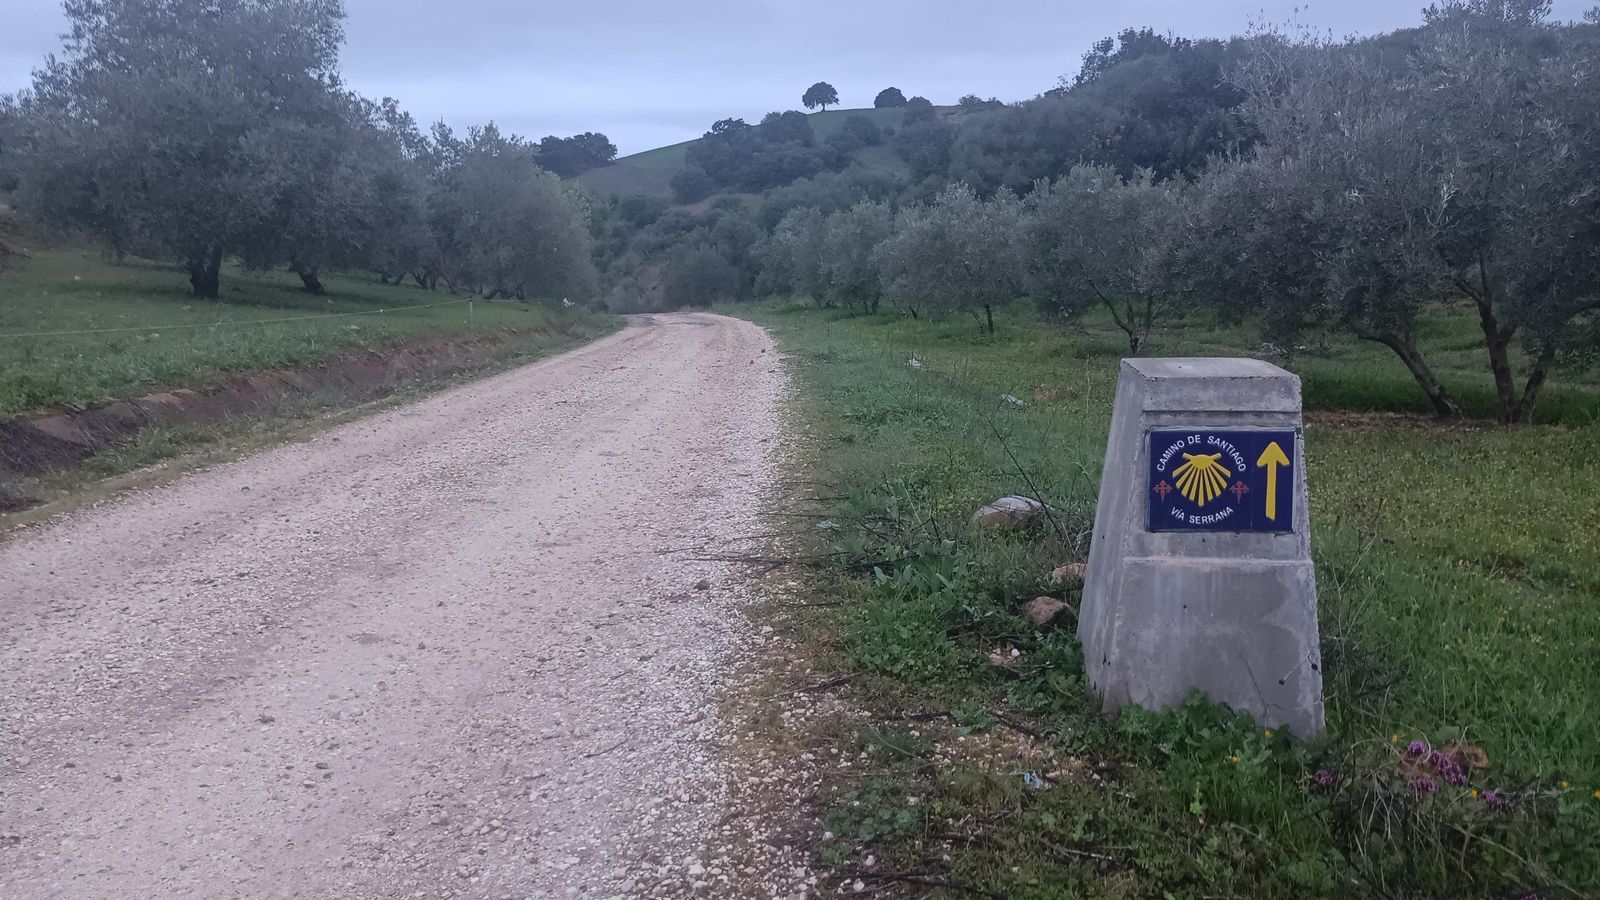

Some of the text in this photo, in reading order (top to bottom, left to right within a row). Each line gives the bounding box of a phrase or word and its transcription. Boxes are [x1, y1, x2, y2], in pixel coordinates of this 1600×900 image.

[1156, 434, 1247, 472] CAMINO DE SANTIAGO
[1189, 506, 1234, 524] SERRANA
